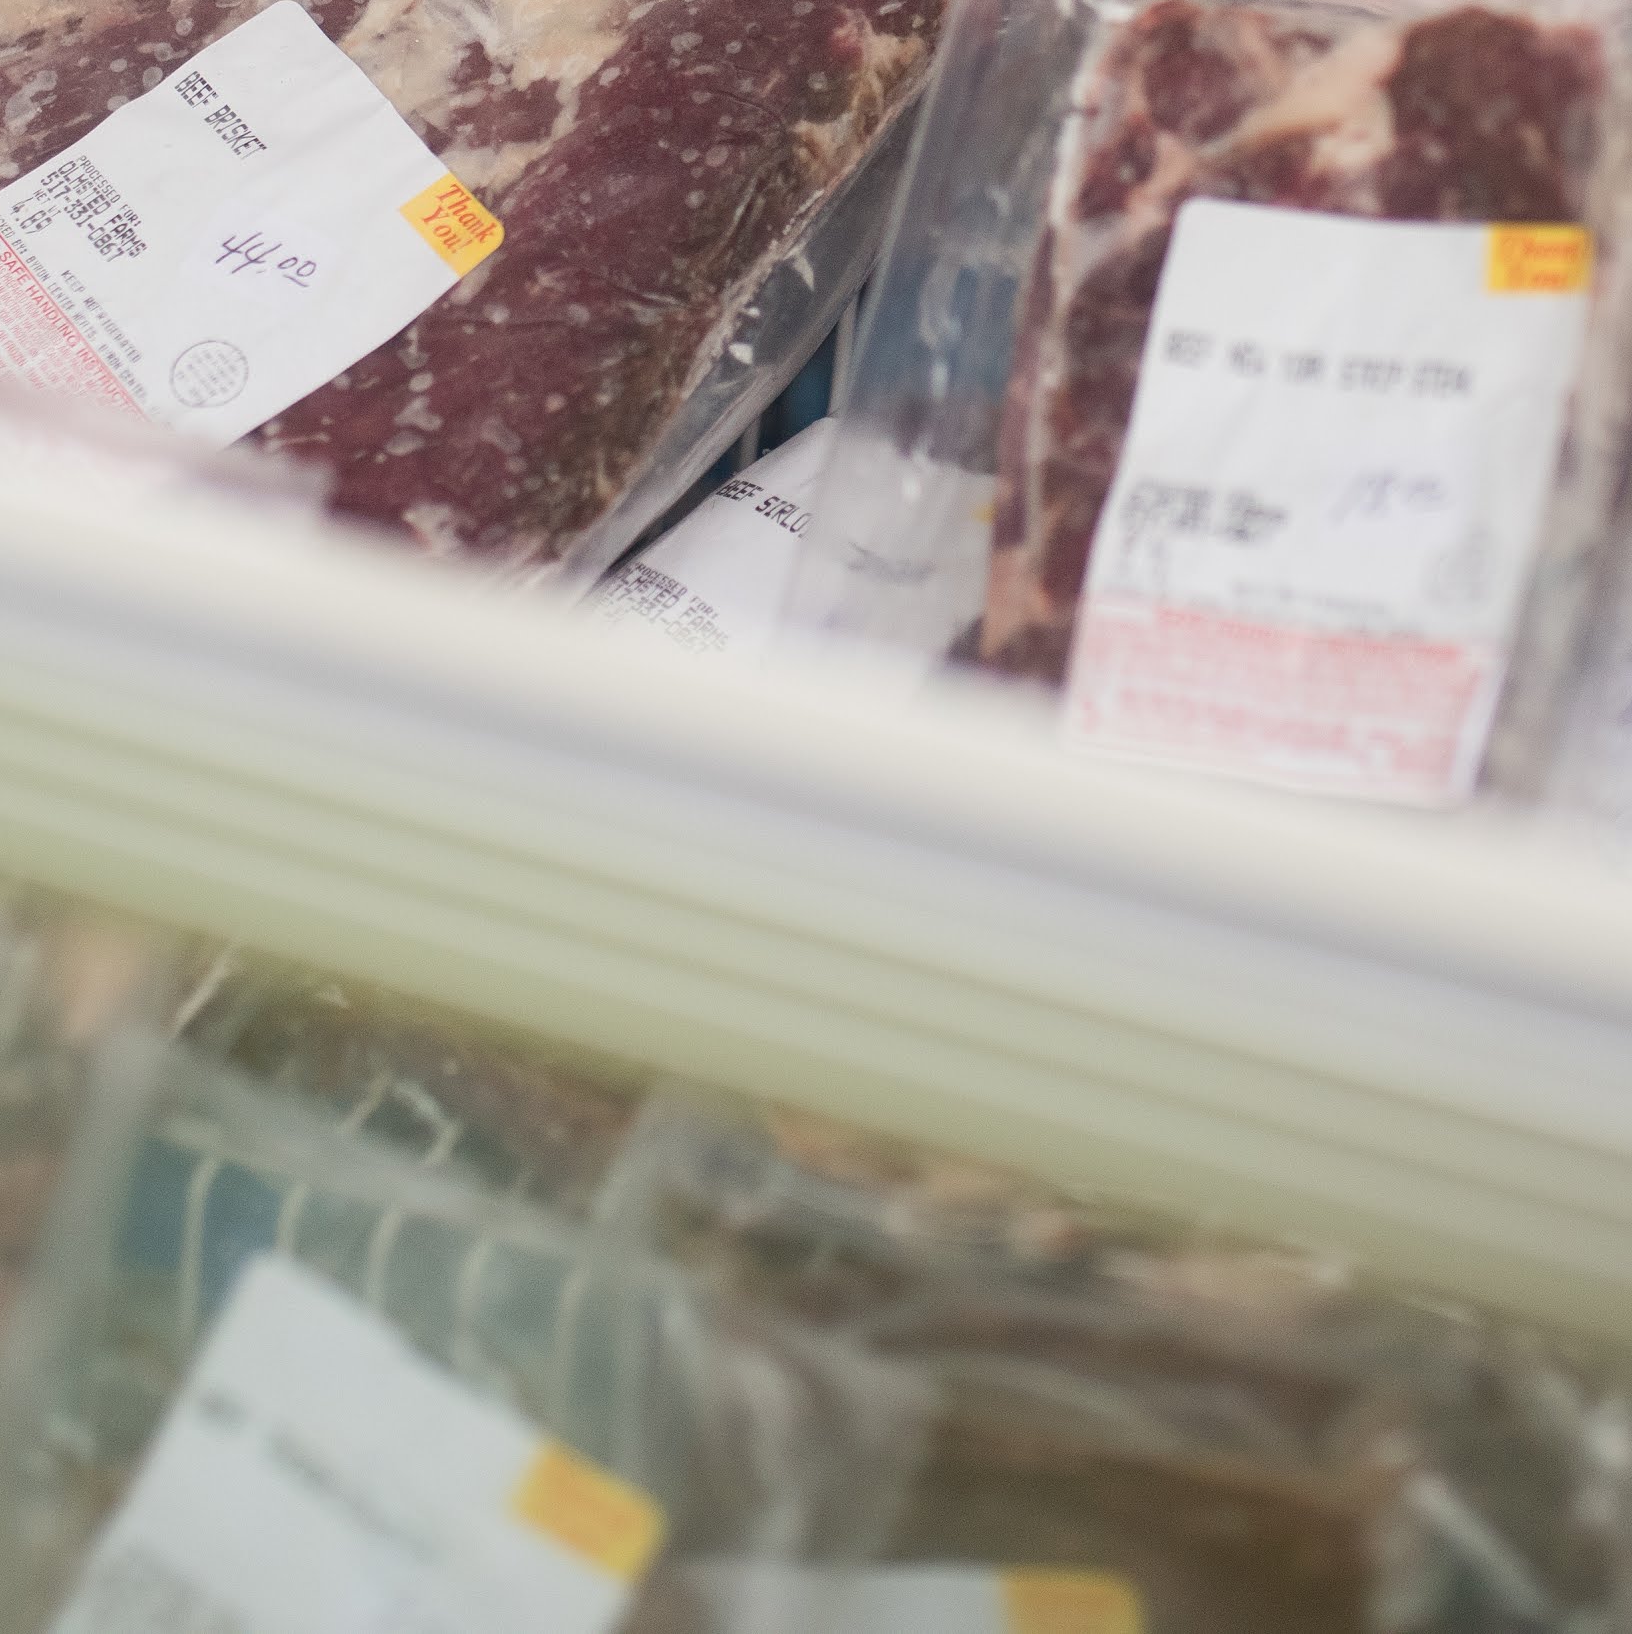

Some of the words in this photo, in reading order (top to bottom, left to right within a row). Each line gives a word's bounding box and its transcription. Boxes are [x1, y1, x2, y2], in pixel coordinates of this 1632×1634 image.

[173, 71, 219, 109] BEEF
[203, 104, 267, 160] BRISKET
[56, 159, 112, 216] OLMSTED
[102, 214, 149, 259] FARMS
[77, 154, 122, 203] PROCESSED
[39, 171, 125, 262] 517-331-0867
[422, 207, 474, 253] You!
[435, 183, 497, 244] Thank
[0, 251, 30, 285] SAFE
[26, 284, 85, 345] HANDLING
[715, 479, 764, 502] BEEF
[754, 495, 815, 539] SIRLO
[634, 562, 688, 597] ROCESSED
